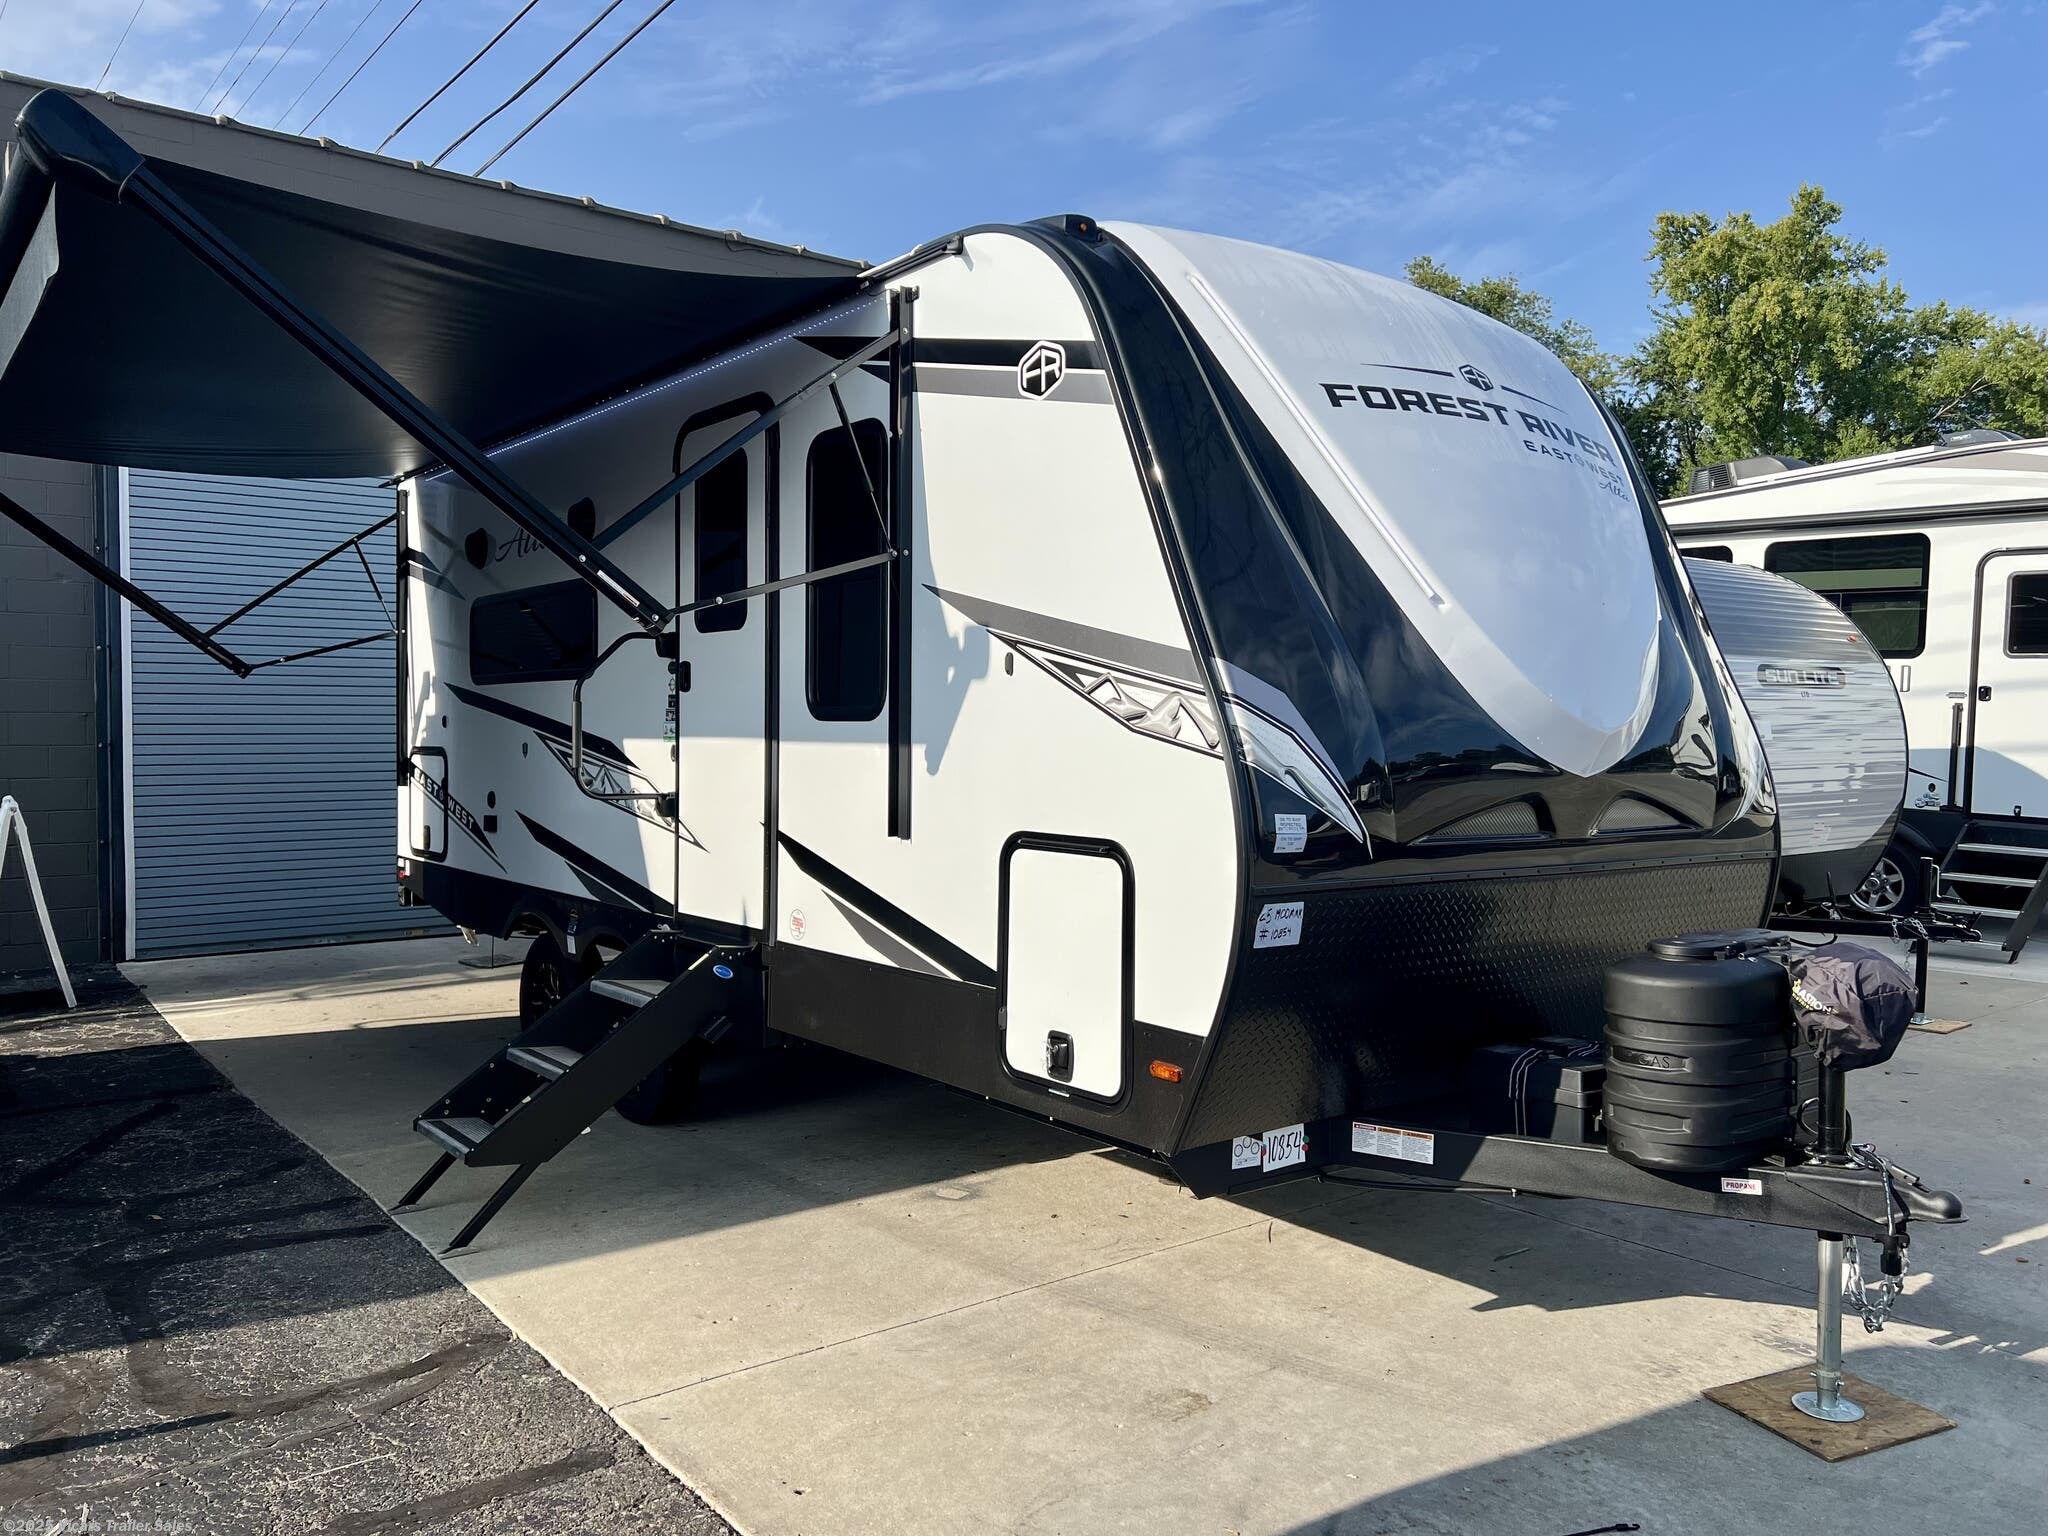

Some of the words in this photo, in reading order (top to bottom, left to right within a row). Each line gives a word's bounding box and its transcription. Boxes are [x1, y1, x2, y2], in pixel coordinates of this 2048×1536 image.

[1319, 382, 1509, 426] FOREST
[1515, 409, 1618, 468] RIVER
[413, 766, 438, 797] EAST
[447, 796, 475, 830] WEST
[1639, 1053, 1670, 1068] GAS
[1268, 1130, 1302, 1164] 10854
